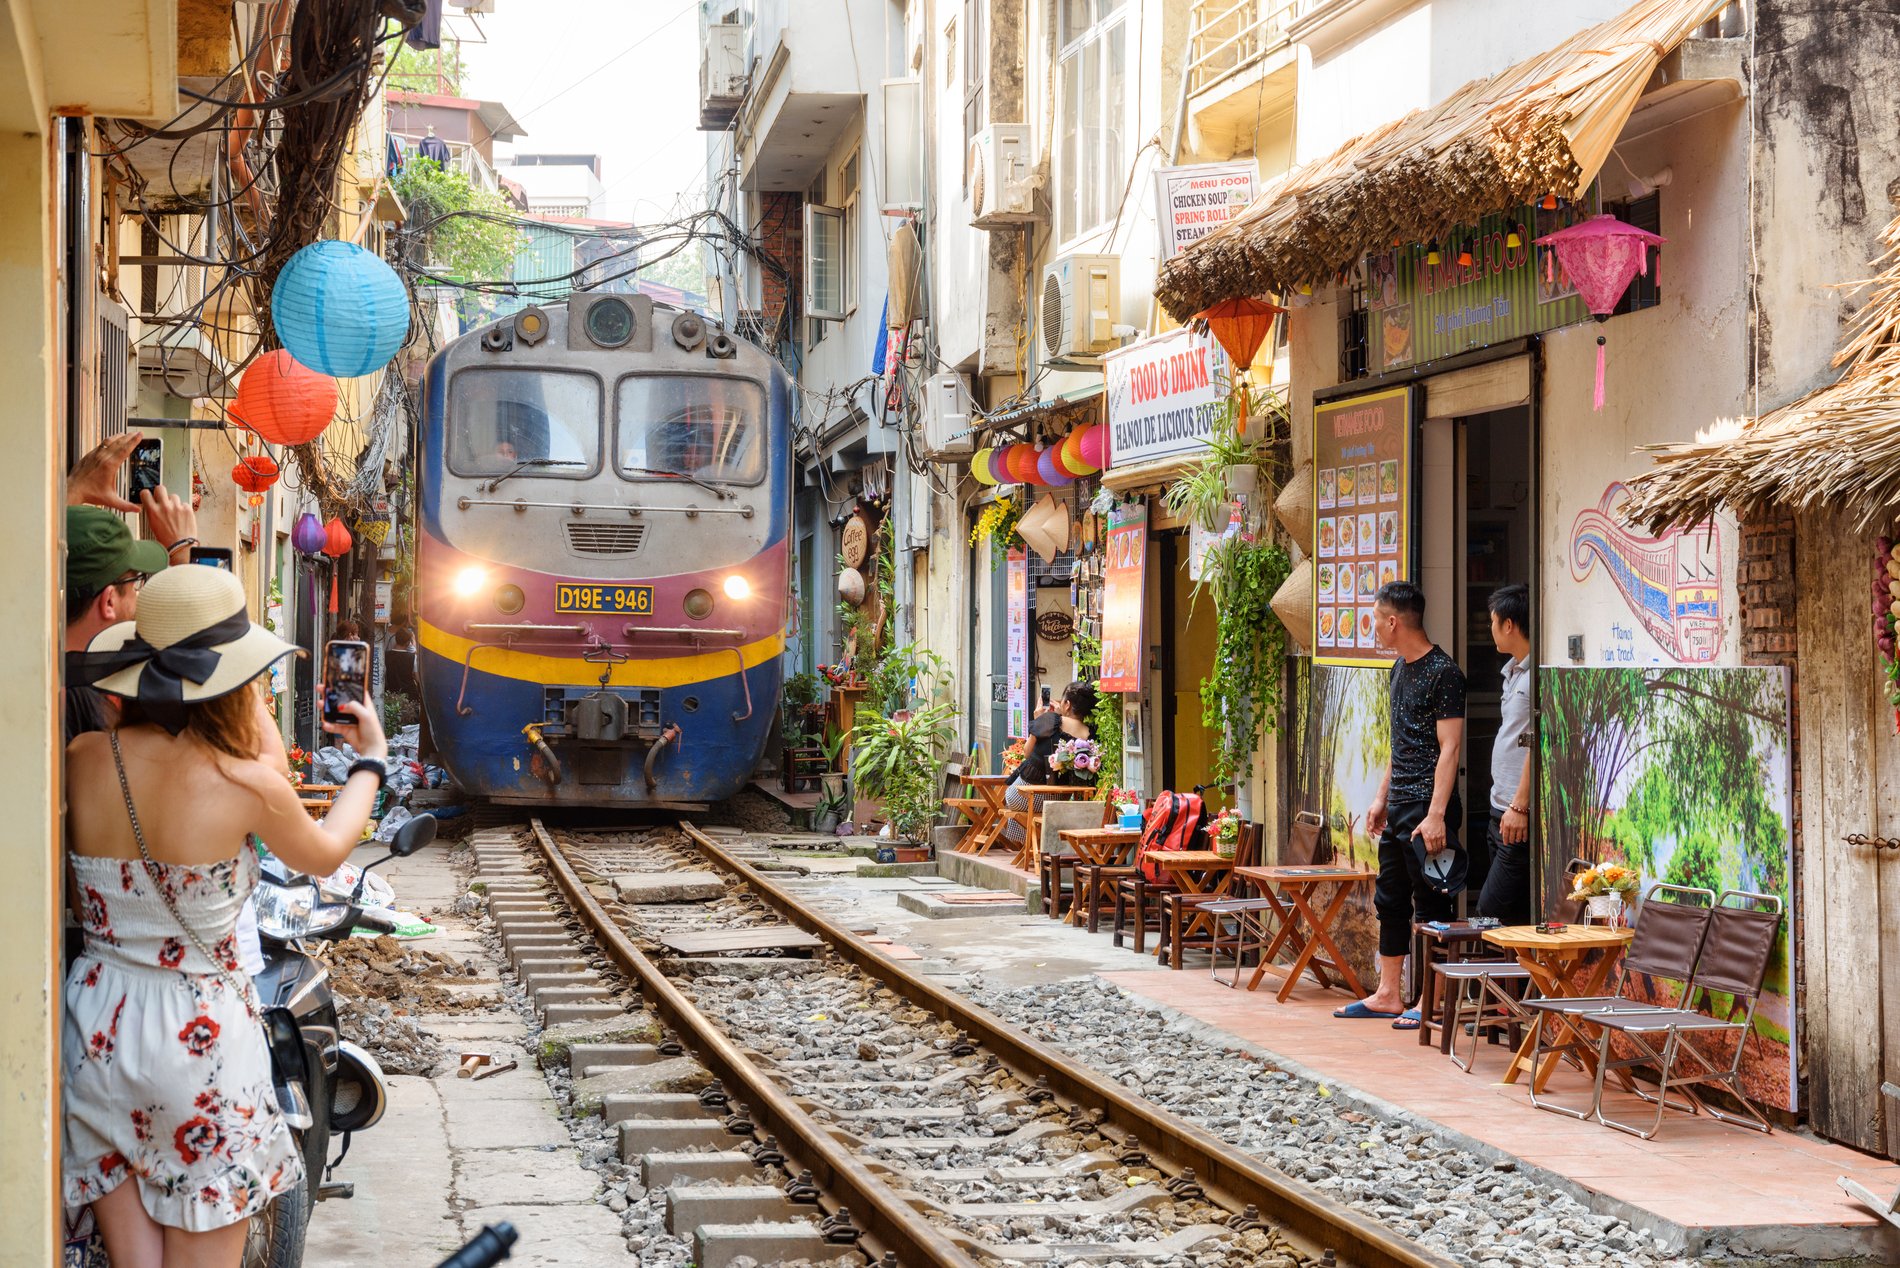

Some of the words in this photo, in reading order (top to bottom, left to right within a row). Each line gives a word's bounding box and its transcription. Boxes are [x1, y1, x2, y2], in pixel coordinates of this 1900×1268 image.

[1190, 180, 1218, 189] MENU
[1220, 177, 1249, 186] FOOD
[1173, 193, 1206, 209] CHICKEN
[1207, 191, 1228, 205] SOUP
[1175, 210, 1205, 225] SPRING
[1207, 208, 1228, 222] ROLL
[1176, 226, 1206, 241] STEAM
[1483, 223, 1529, 278] FOOD
[1130, 361, 1158, 406] FOOD
[1160, 358, 1169, 397] &
[1170, 346, 1209, 394] DRINK
[1115, 418, 1144, 451] HANOI
[1144, 415, 1157, 446] DE
[1157, 407, 1194, 443] LICIOUS
[844, 528, 863, 547] Coffee
[848, 545, 859, 563] egg
[1037, 619, 1072, 634] Welcome
[1611, 621, 1633, 641] Hanoi
